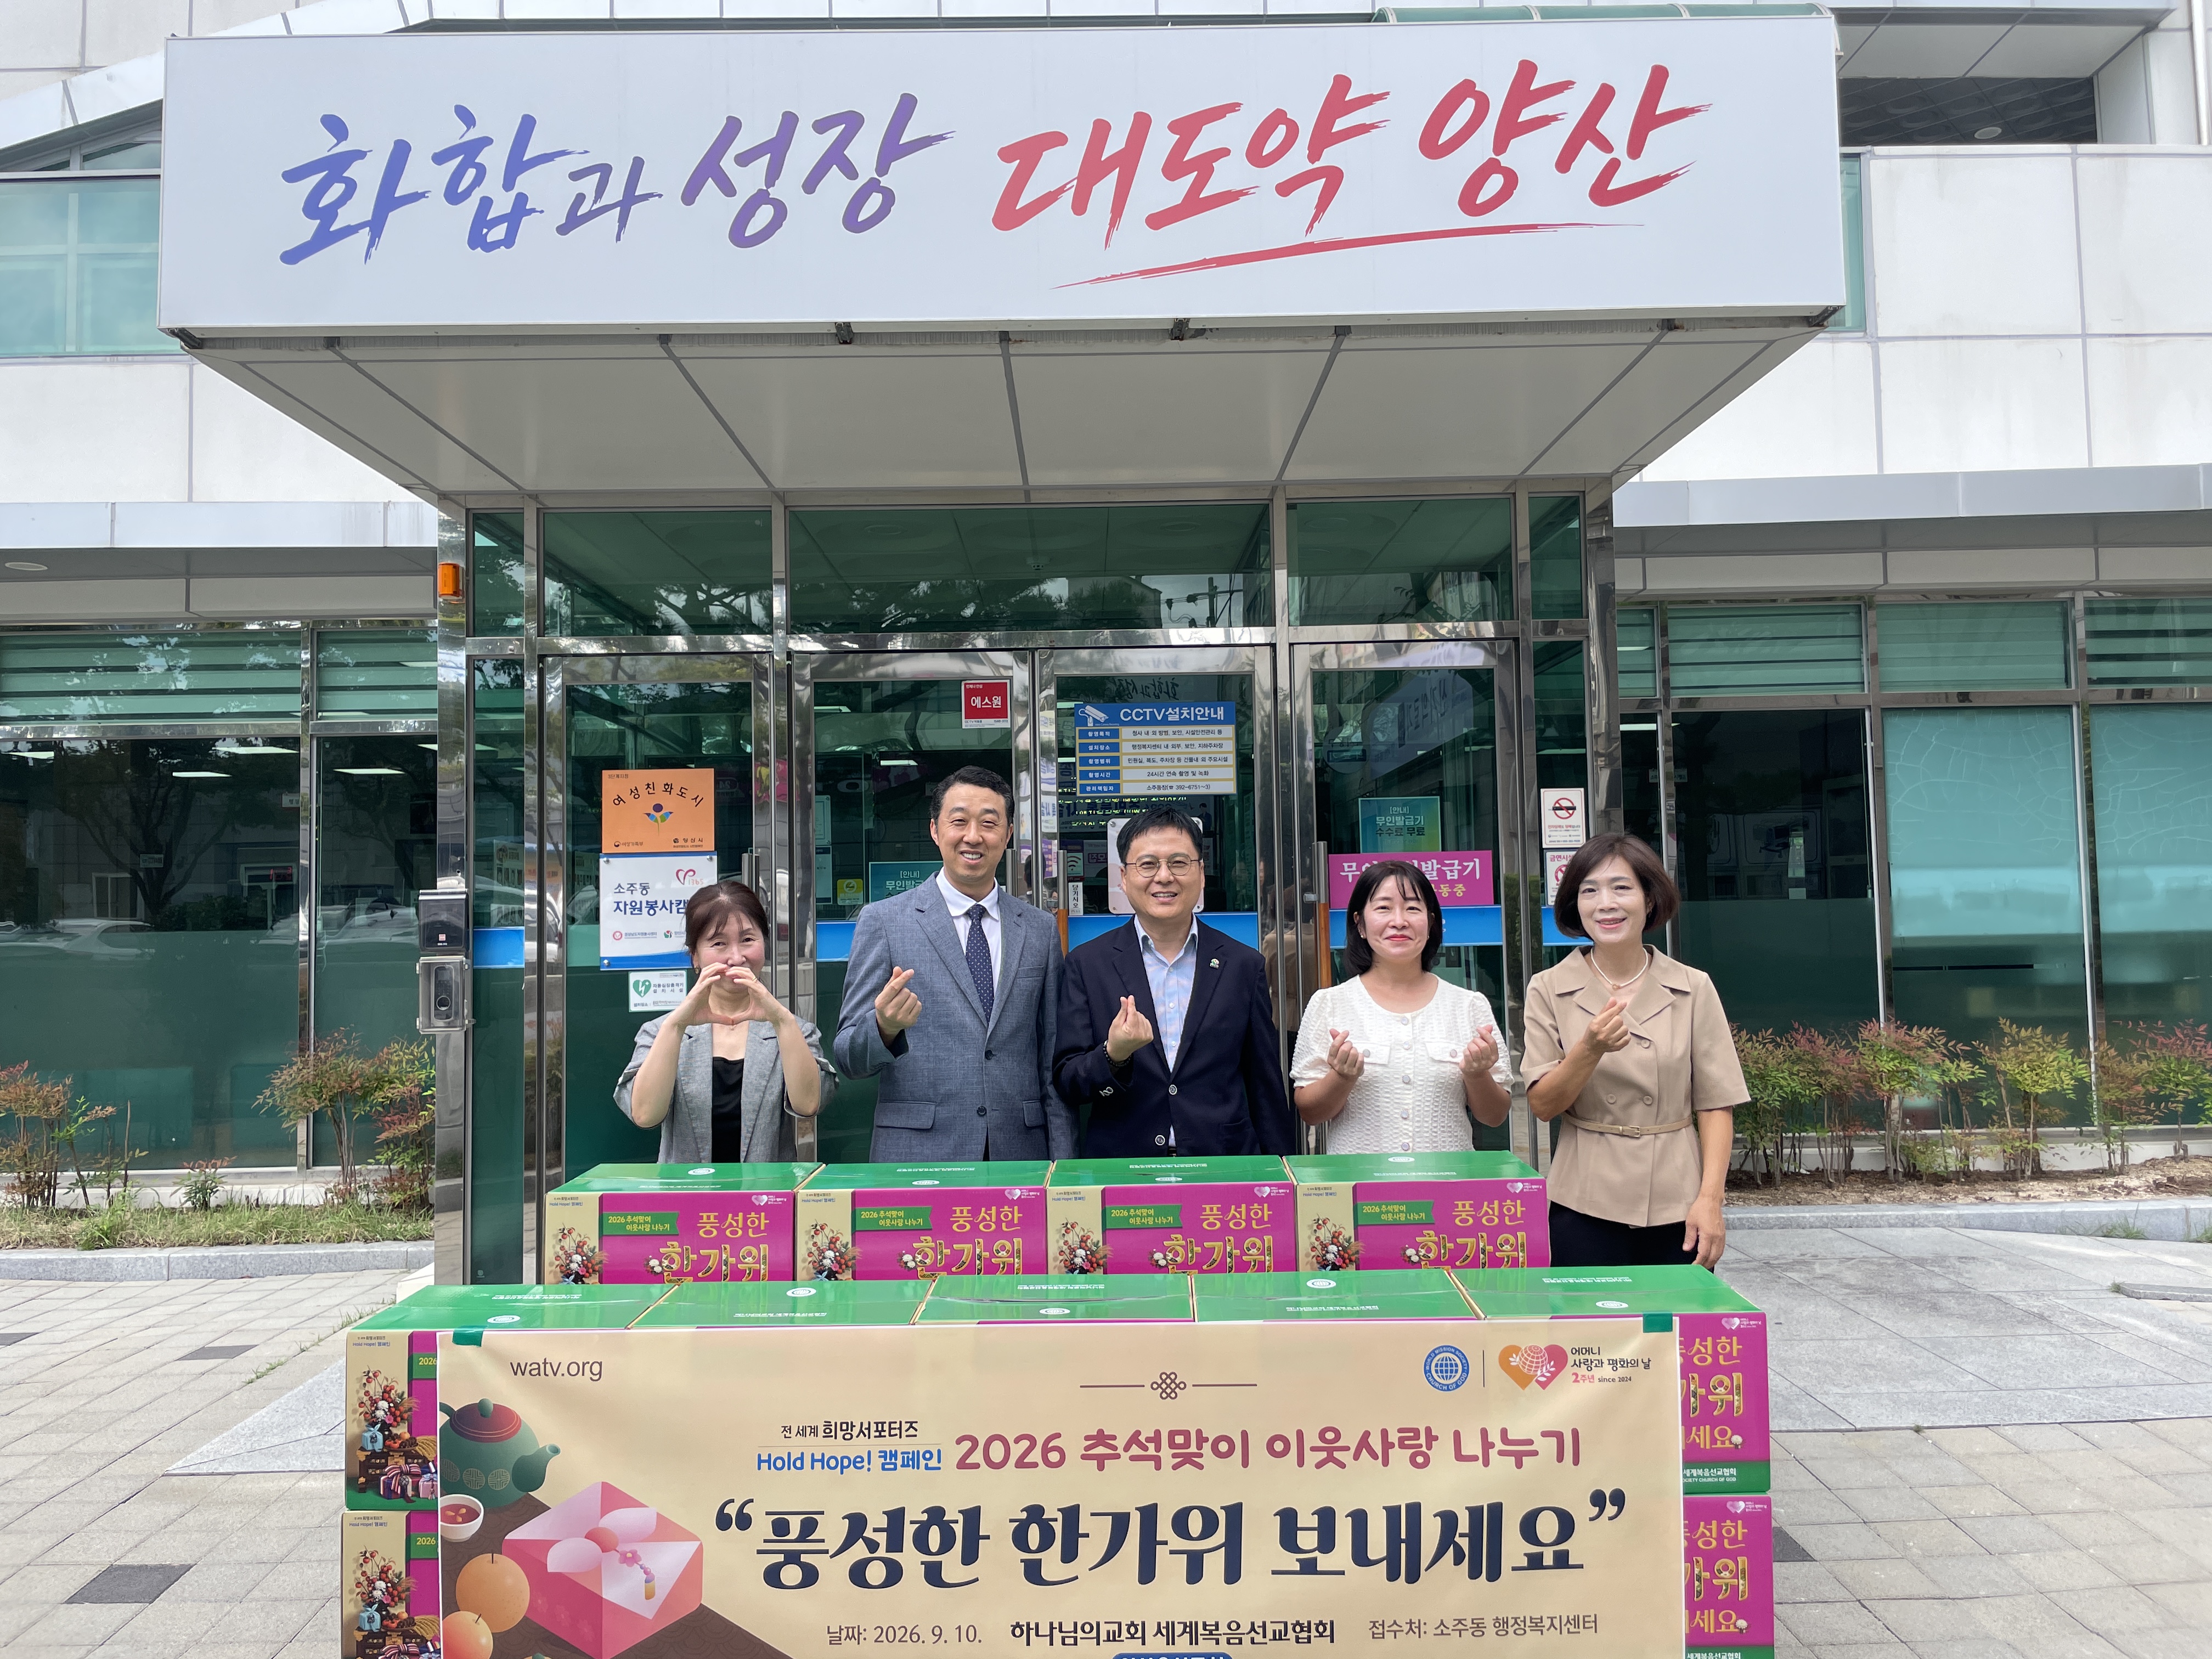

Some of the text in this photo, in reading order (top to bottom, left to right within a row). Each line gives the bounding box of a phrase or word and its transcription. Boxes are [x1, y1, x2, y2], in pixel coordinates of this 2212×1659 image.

[280, 59, 1713, 265] 화합과 성장 대도약 양산
[970, 696, 1002, 708] 에스원
[1120, 706, 1224, 721] CCTV설치안내
[1375, 815, 1424, 826] 무인발급기
[1389, 806, 1410, 815] [안내]
[1375, 827, 1426, 837] 수수료 무료
[900, 870, 920, 878] [안내]
[1340, 858, 1480, 883] 무발급기
[613, 883, 650, 895] 소주동
[613, 900, 687, 916] 자원봉사캠
[879, 1210, 904, 1218] 추석맞이
[1111, 1208, 1154, 1217] 2026 추석맞이
[1200, 1203, 1273, 1230] 풍성한
[1363, 1204, 1406, 1213] 2026 추석맞이
[1381, 1212, 1425, 1221] 이웃사랑 나누기
[1452, 1200, 1526, 1227] 풍성한
[626, 1215, 651, 1223] 추석맞이
[626, 1223, 670, 1232] 이웃사랑 나누기
[697, 1212, 769, 1238] 풍성한
[879, 1218, 923, 1227] 이웃사랑 나누기
[950, 1205, 1023, 1233] 풍성한
[1129, 1216, 1173, 1224] 이웃사랑 나누기
[912, 1235, 1022, 1280] 한가위
[1163, 1234, 1273, 1274] 한가위
[1415, 1230, 1527, 1269] 한가위
[659, 1242, 769, 1284] 한가위
[1455, 1351, 1468, 1371] SOCIETY
[1571, 1347, 1600, 1356] 어머니
[1679, 1336, 1742, 1366] 성한
[510, 1357, 603, 1382] watv.org
[1571, 1358, 1651, 1370] 사랑과 평화의 날
[1426, 1373, 1447, 1391] CHURCH
[1457, 1373, 1468, 1385] GOD
[1571, 1373, 1595, 1383] 2주년
[781, 1420, 918, 1440] 전 세계 희망서포터즈
[1682, 1425, 1735, 1450] 세요
[955, 1426, 1581, 1471] 2026 추석맞이 이웃사랑 나누기
[757, 1449, 943, 1474] Hold Hope! 캠페인
[416, 1537, 436, 1545] 2026
[1008, 1502, 1244, 1587] 한가위
[1684, 1520, 1748, 1549] 성한
[1368, 1613, 1599, 1640] 접수처: 소주동 행정복지센터
[1685, 1609, 1738, 1634] 세요
[827, 1625, 983, 1645] 날짜: 2026. 9. 10.
[1010, 1620, 1335, 1646] 하나님의교회 세계복음선교협회
